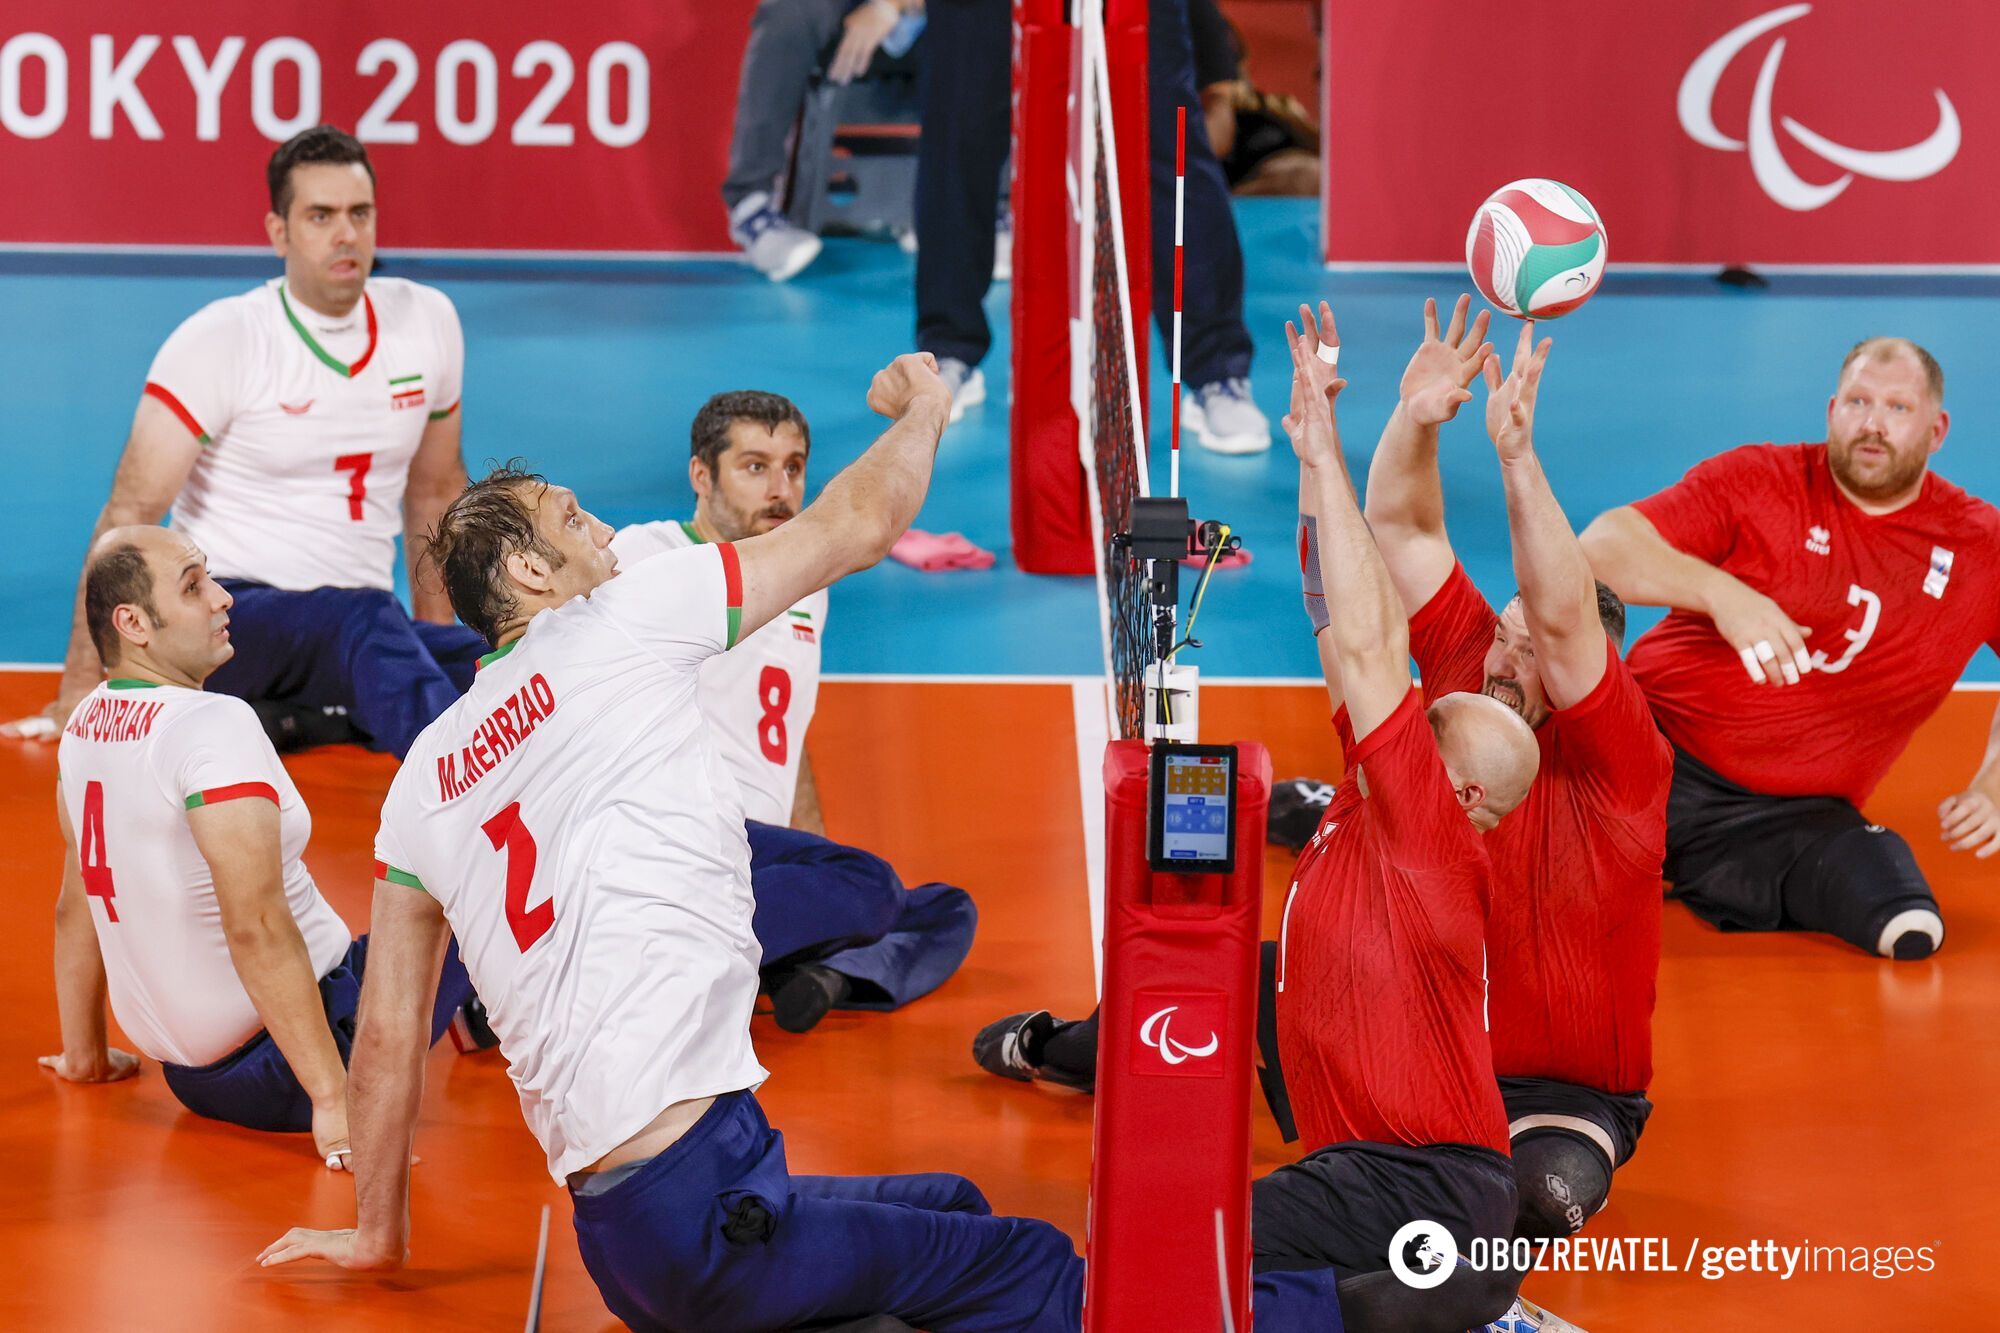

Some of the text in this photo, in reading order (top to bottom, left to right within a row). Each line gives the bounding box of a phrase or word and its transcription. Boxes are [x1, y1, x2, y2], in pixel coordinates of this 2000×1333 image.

[0, 33, 650, 147] OKYO 2020
[334, 452, 373, 521] 7
[1812, 584, 1881, 673] 3
[757, 665, 792, 767] 8
[80, 780, 120, 923] 4
[481, 801, 555, 954] 2
